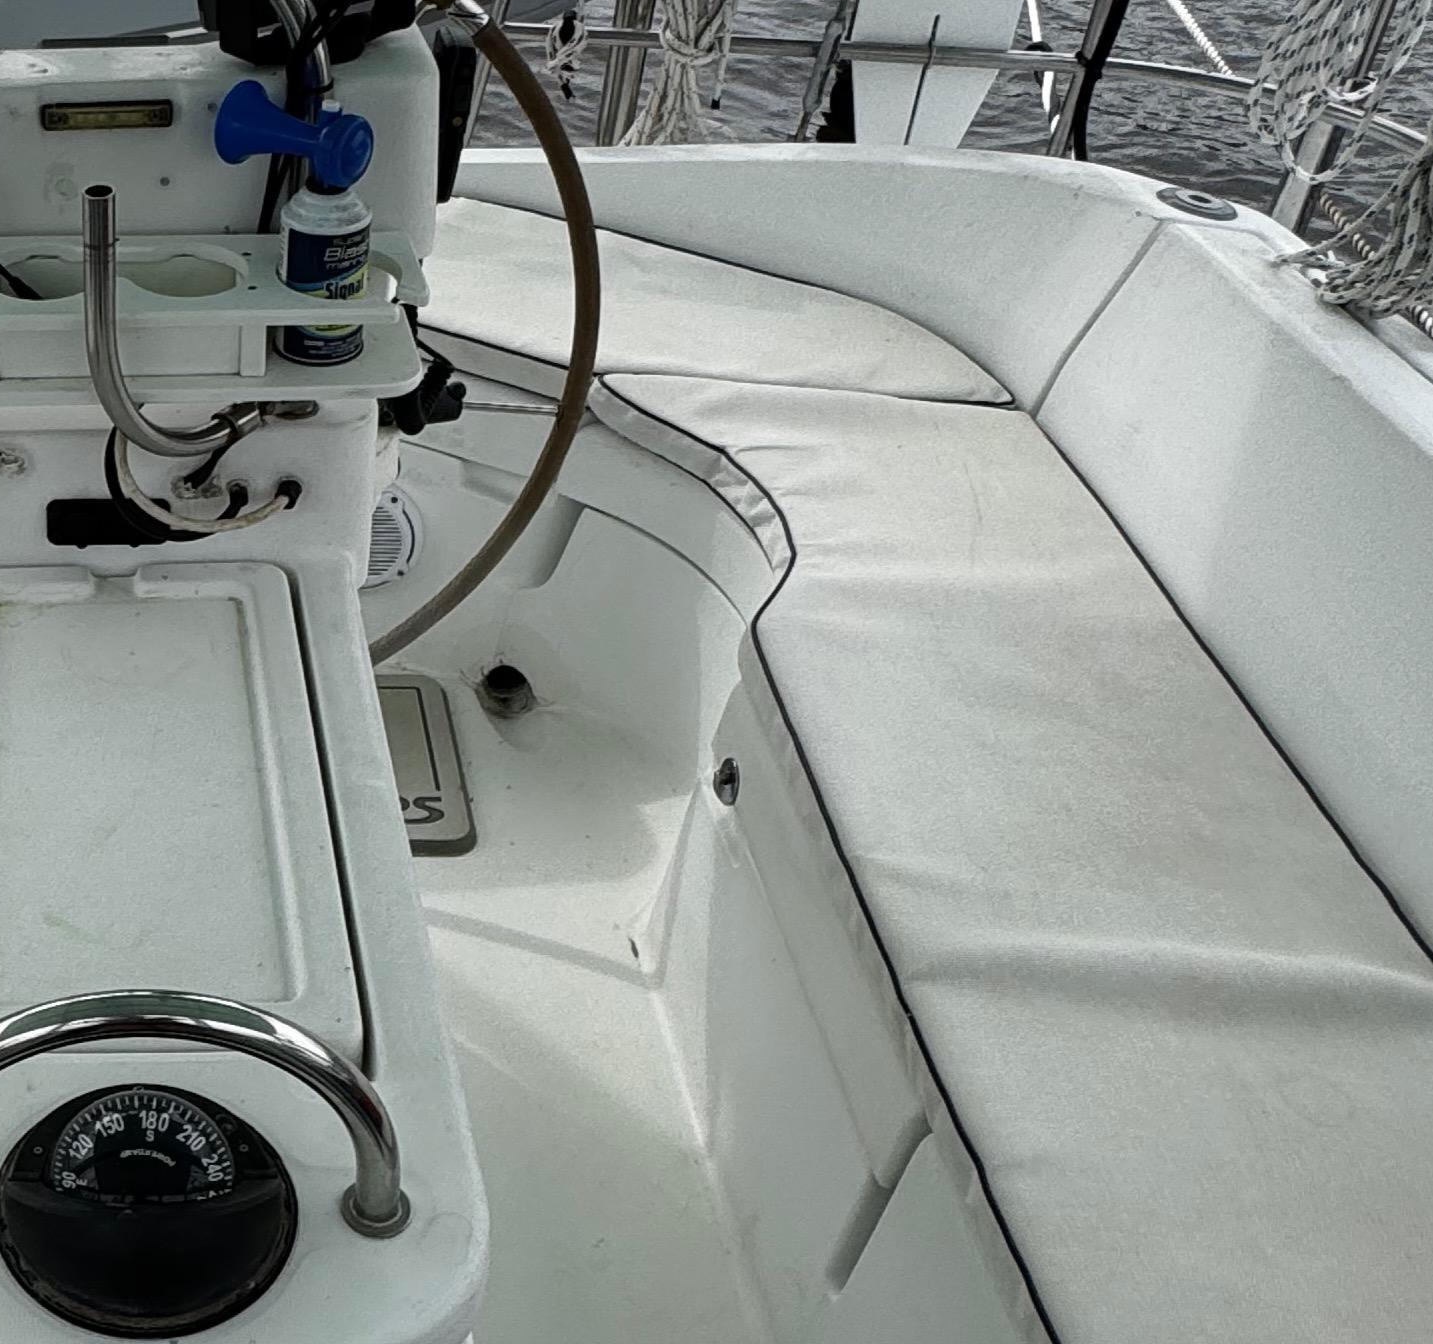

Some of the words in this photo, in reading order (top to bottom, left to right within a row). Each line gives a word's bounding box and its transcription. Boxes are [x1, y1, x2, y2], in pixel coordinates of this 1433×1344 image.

[324, 243, 369, 262] Blas
[94, 1113, 125, 1138] 150
[139, 1110, 169, 1132] 180
[69, 1133, 94, 1160] 120
[145, 1131, 155, 1142] S
[176, 1124, 206, 1151] 210
[201, 1154, 224, 1182] 240
[61, 1171, 77, 1189] 90
